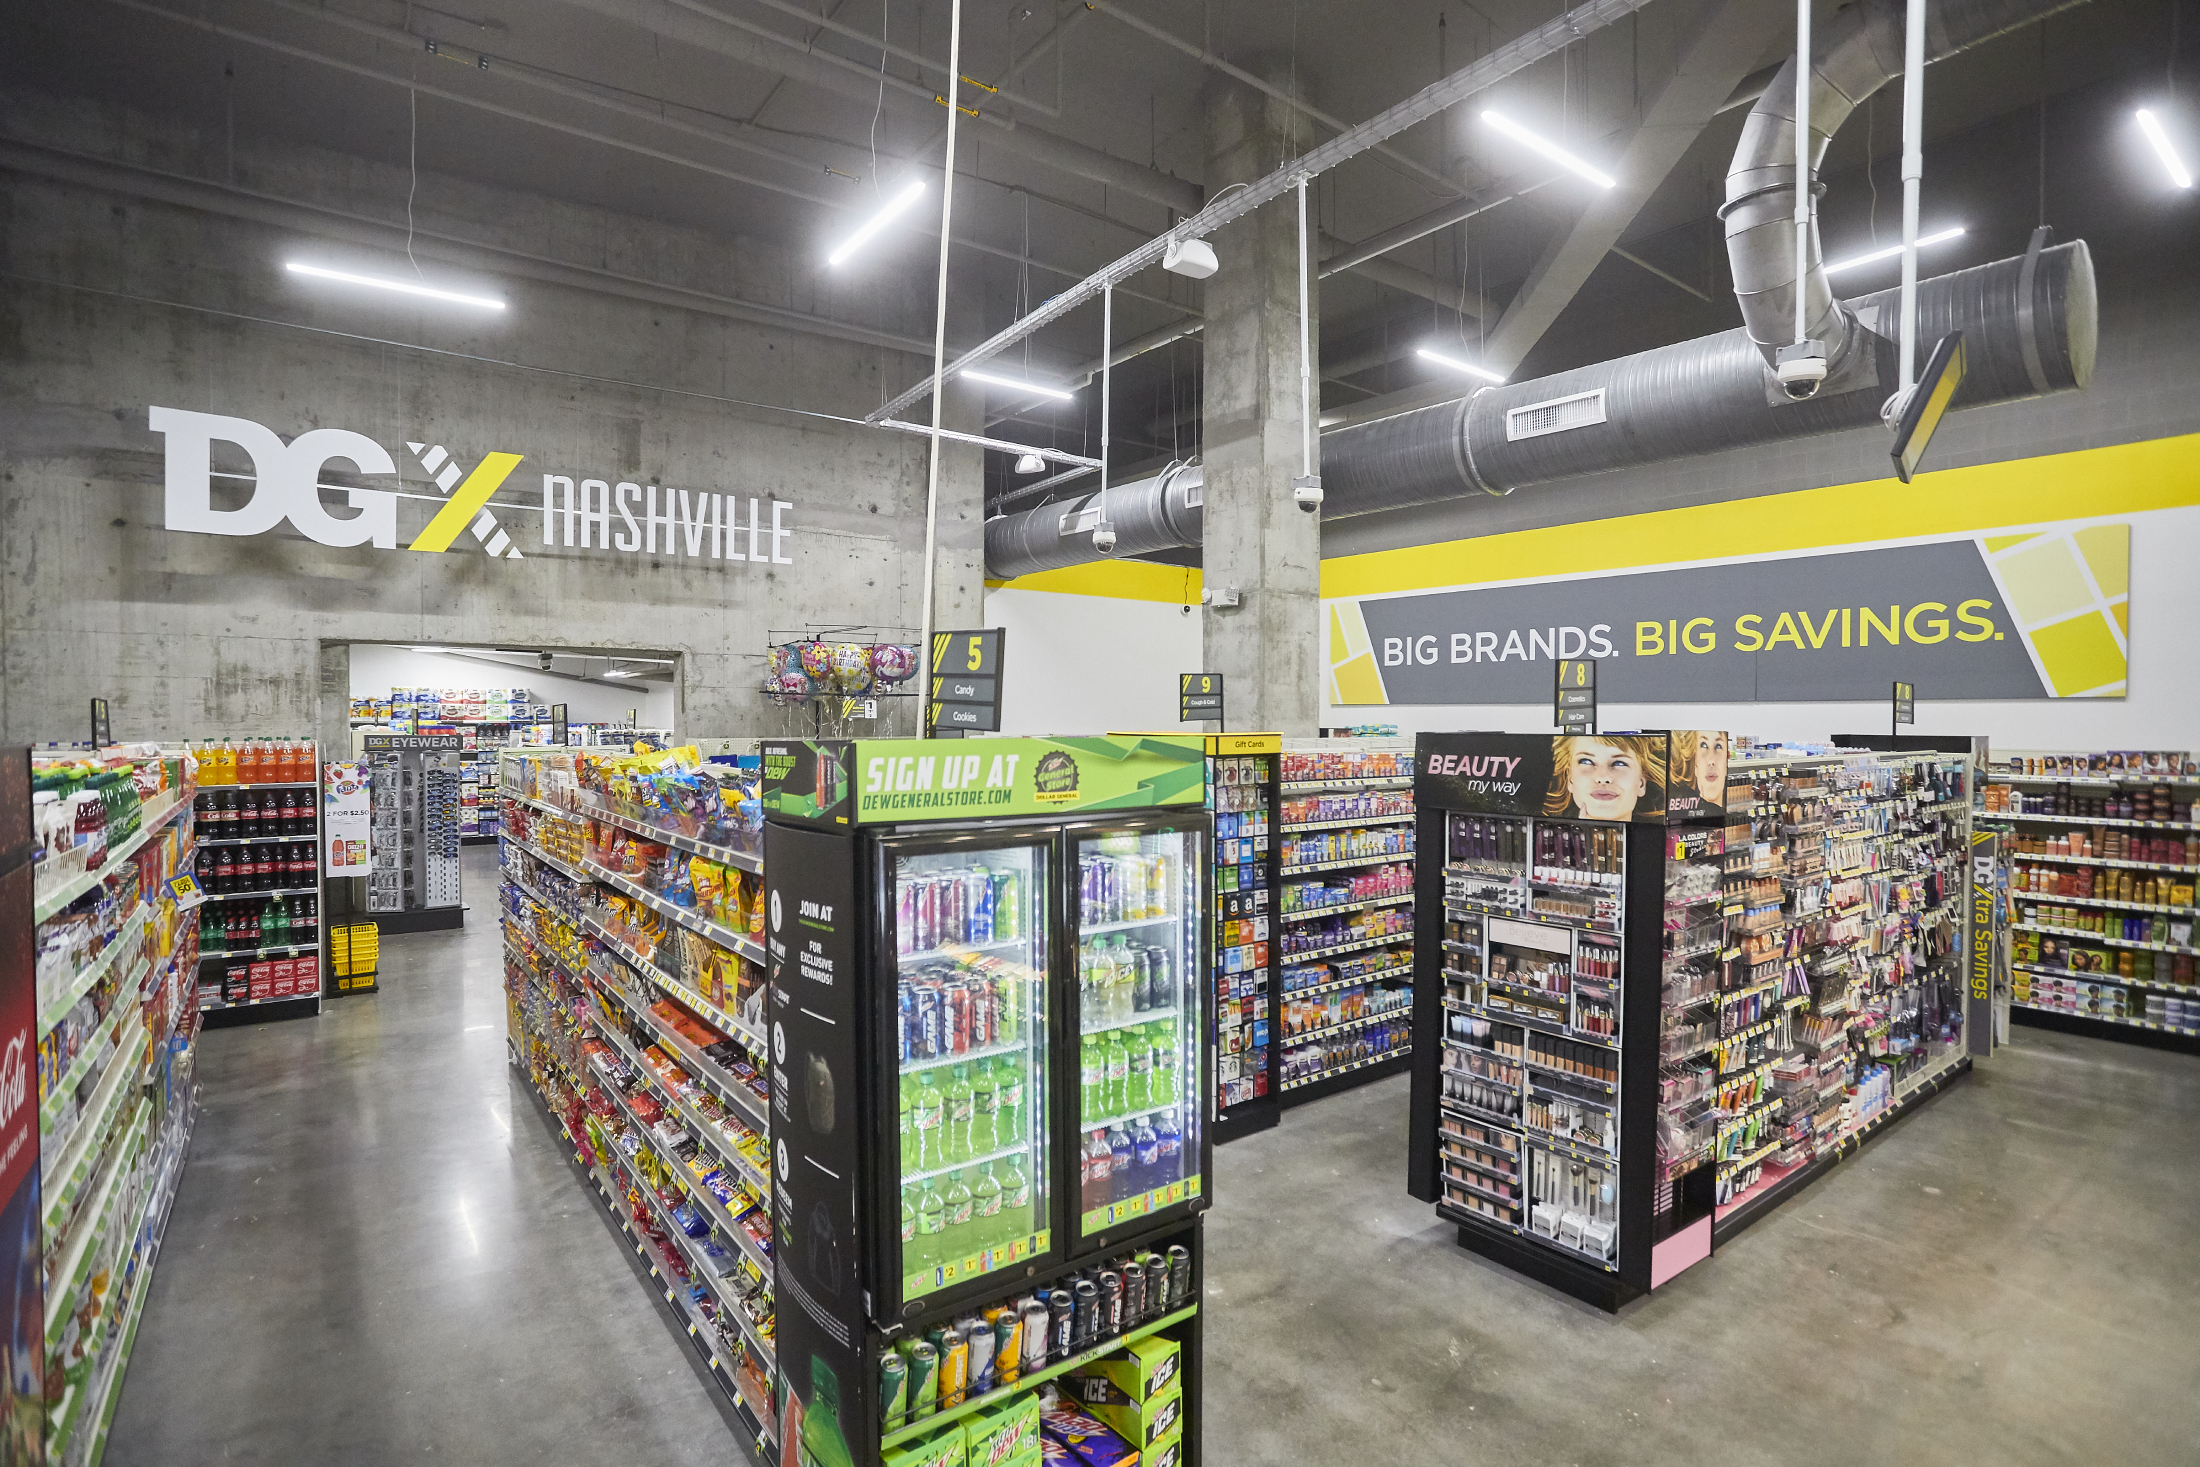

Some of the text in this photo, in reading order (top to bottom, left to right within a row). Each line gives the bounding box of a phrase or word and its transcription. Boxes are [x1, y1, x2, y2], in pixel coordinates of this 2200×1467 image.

[543, 474, 793, 565] NASHVILLE
[1383, 598, 2004, 667] BIG BRANDS. BIG SAVINGS.
[966, 636, 983, 671] 5
[1201, 676, 1211, 693] 9
[1577, 663, 1586, 686] 8
[954, 684, 974, 696] Candy
[953, 711, 977, 722] Cookies
[392, 737, 458, 748] EYEWEAR
[1247, 740, 1265, 748] Cards
[866, 753, 1020, 793] SIGN UP AT
[1427, 754, 1522, 779] BEAUTY
[336, 783, 359, 795] Fanta
[1045, 778, 1071, 792] Store
[1468, 779, 1522, 796] my way
[862, 789, 1012, 811] DEWGENERALSTORE.COM
[1668, 797, 1701, 811] BEAUTY
[799, 900, 833, 922] JOIN AT
[809, 940, 822, 955] FOR
[800, 951, 833, 972] EXCLUSIVE
[1970, 930, 1992, 1000] Savings
[801, 965, 833, 986] REWARDS!
[774, 1064, 789, 1092] ENTER
[776, 1178, 792, 1210] REDEEM
[1150, 1355, 1175, 1395] ICE
[1084, 1378, 1108, 1403] ICE
[1152, 1401, 1176, 1440] ICE
[1022, 1435, 1033, 1450] 18
